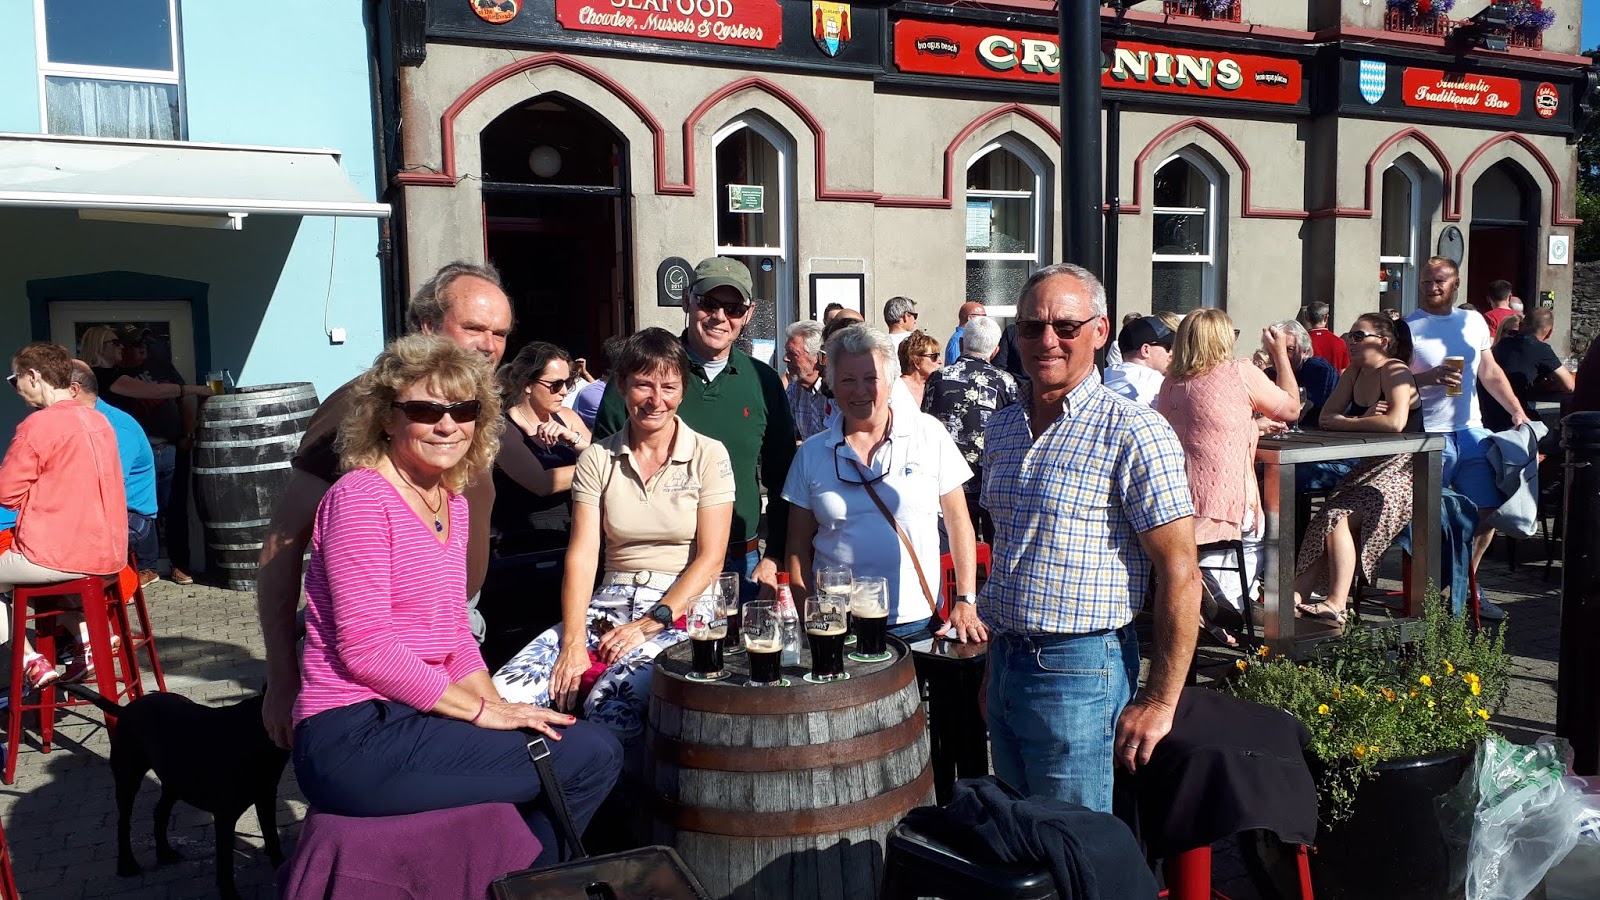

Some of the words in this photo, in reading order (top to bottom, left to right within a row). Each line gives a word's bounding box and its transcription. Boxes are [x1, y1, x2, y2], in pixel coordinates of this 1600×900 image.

[579, 5, 638, 30] Chowder,
[640, 13, 695, 34] Mussels
[697, 19, 712, 39] &
[712, 21, 764, 41] Oysters
[978, 35, 1243, 89] CRNINS
[1415, 85, 1480, 106] Traditional
[1484, 93, 1510, 109] Bar
